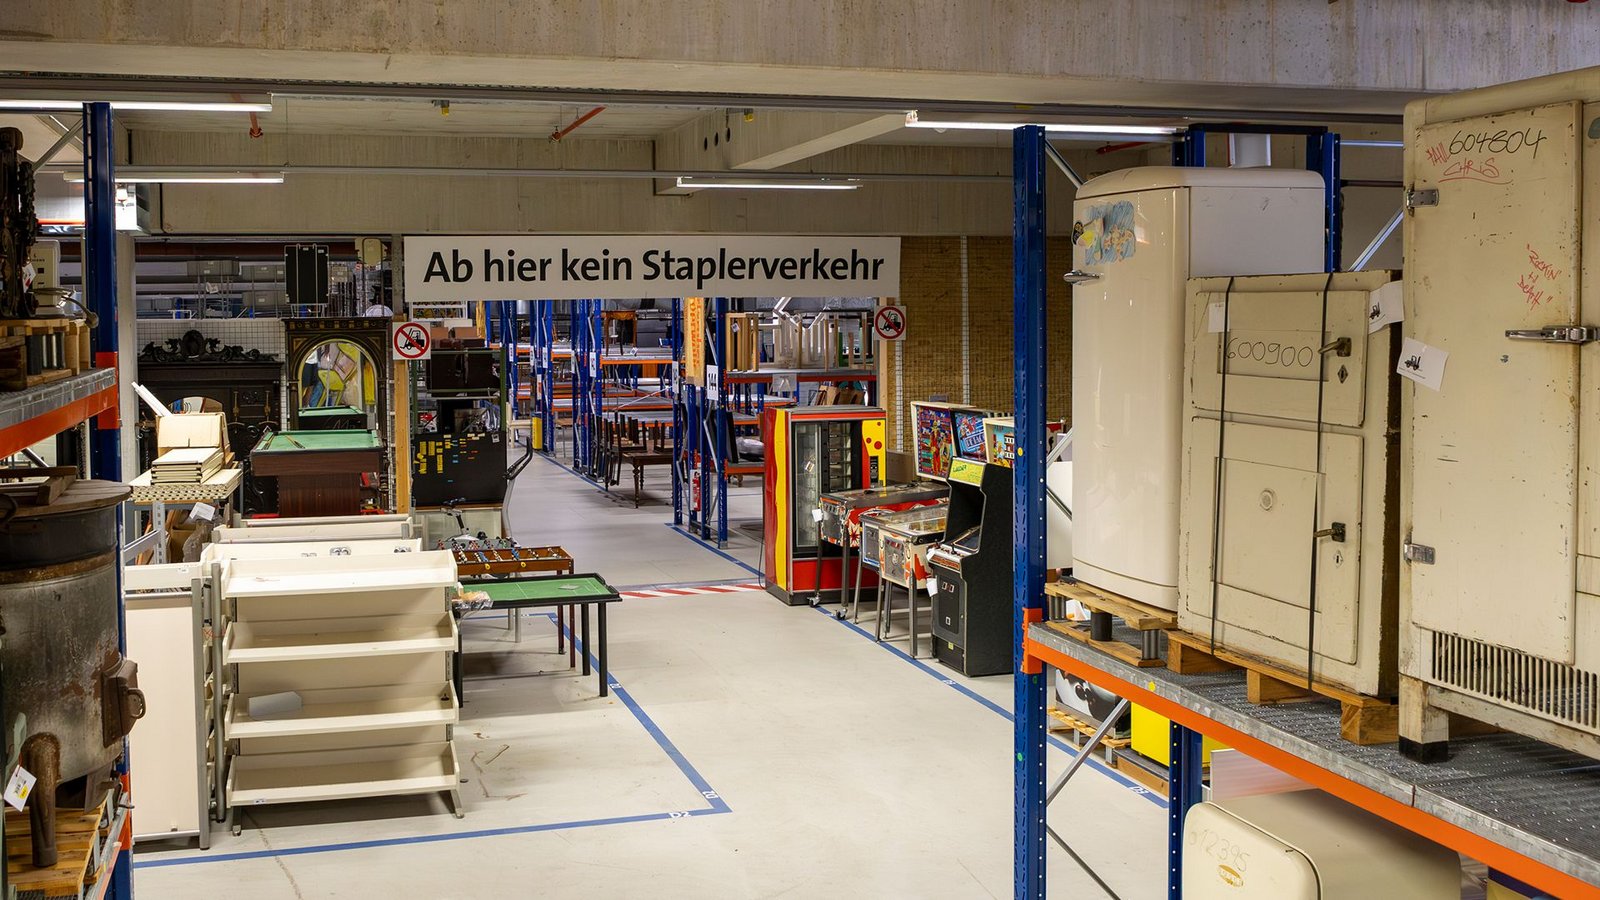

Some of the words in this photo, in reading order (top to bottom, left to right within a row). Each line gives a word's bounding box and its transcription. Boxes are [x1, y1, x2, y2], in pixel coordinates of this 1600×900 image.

[1449, 127, 1548, 159] 604804
[423, 248, 474, 283] Ab
[484, 248, 552, 282] hier
[561, 248, 632, 281] kein
[642, 247, 885, 290] Staplerverkehr
[1225, 336, 1314, 368] 600900
